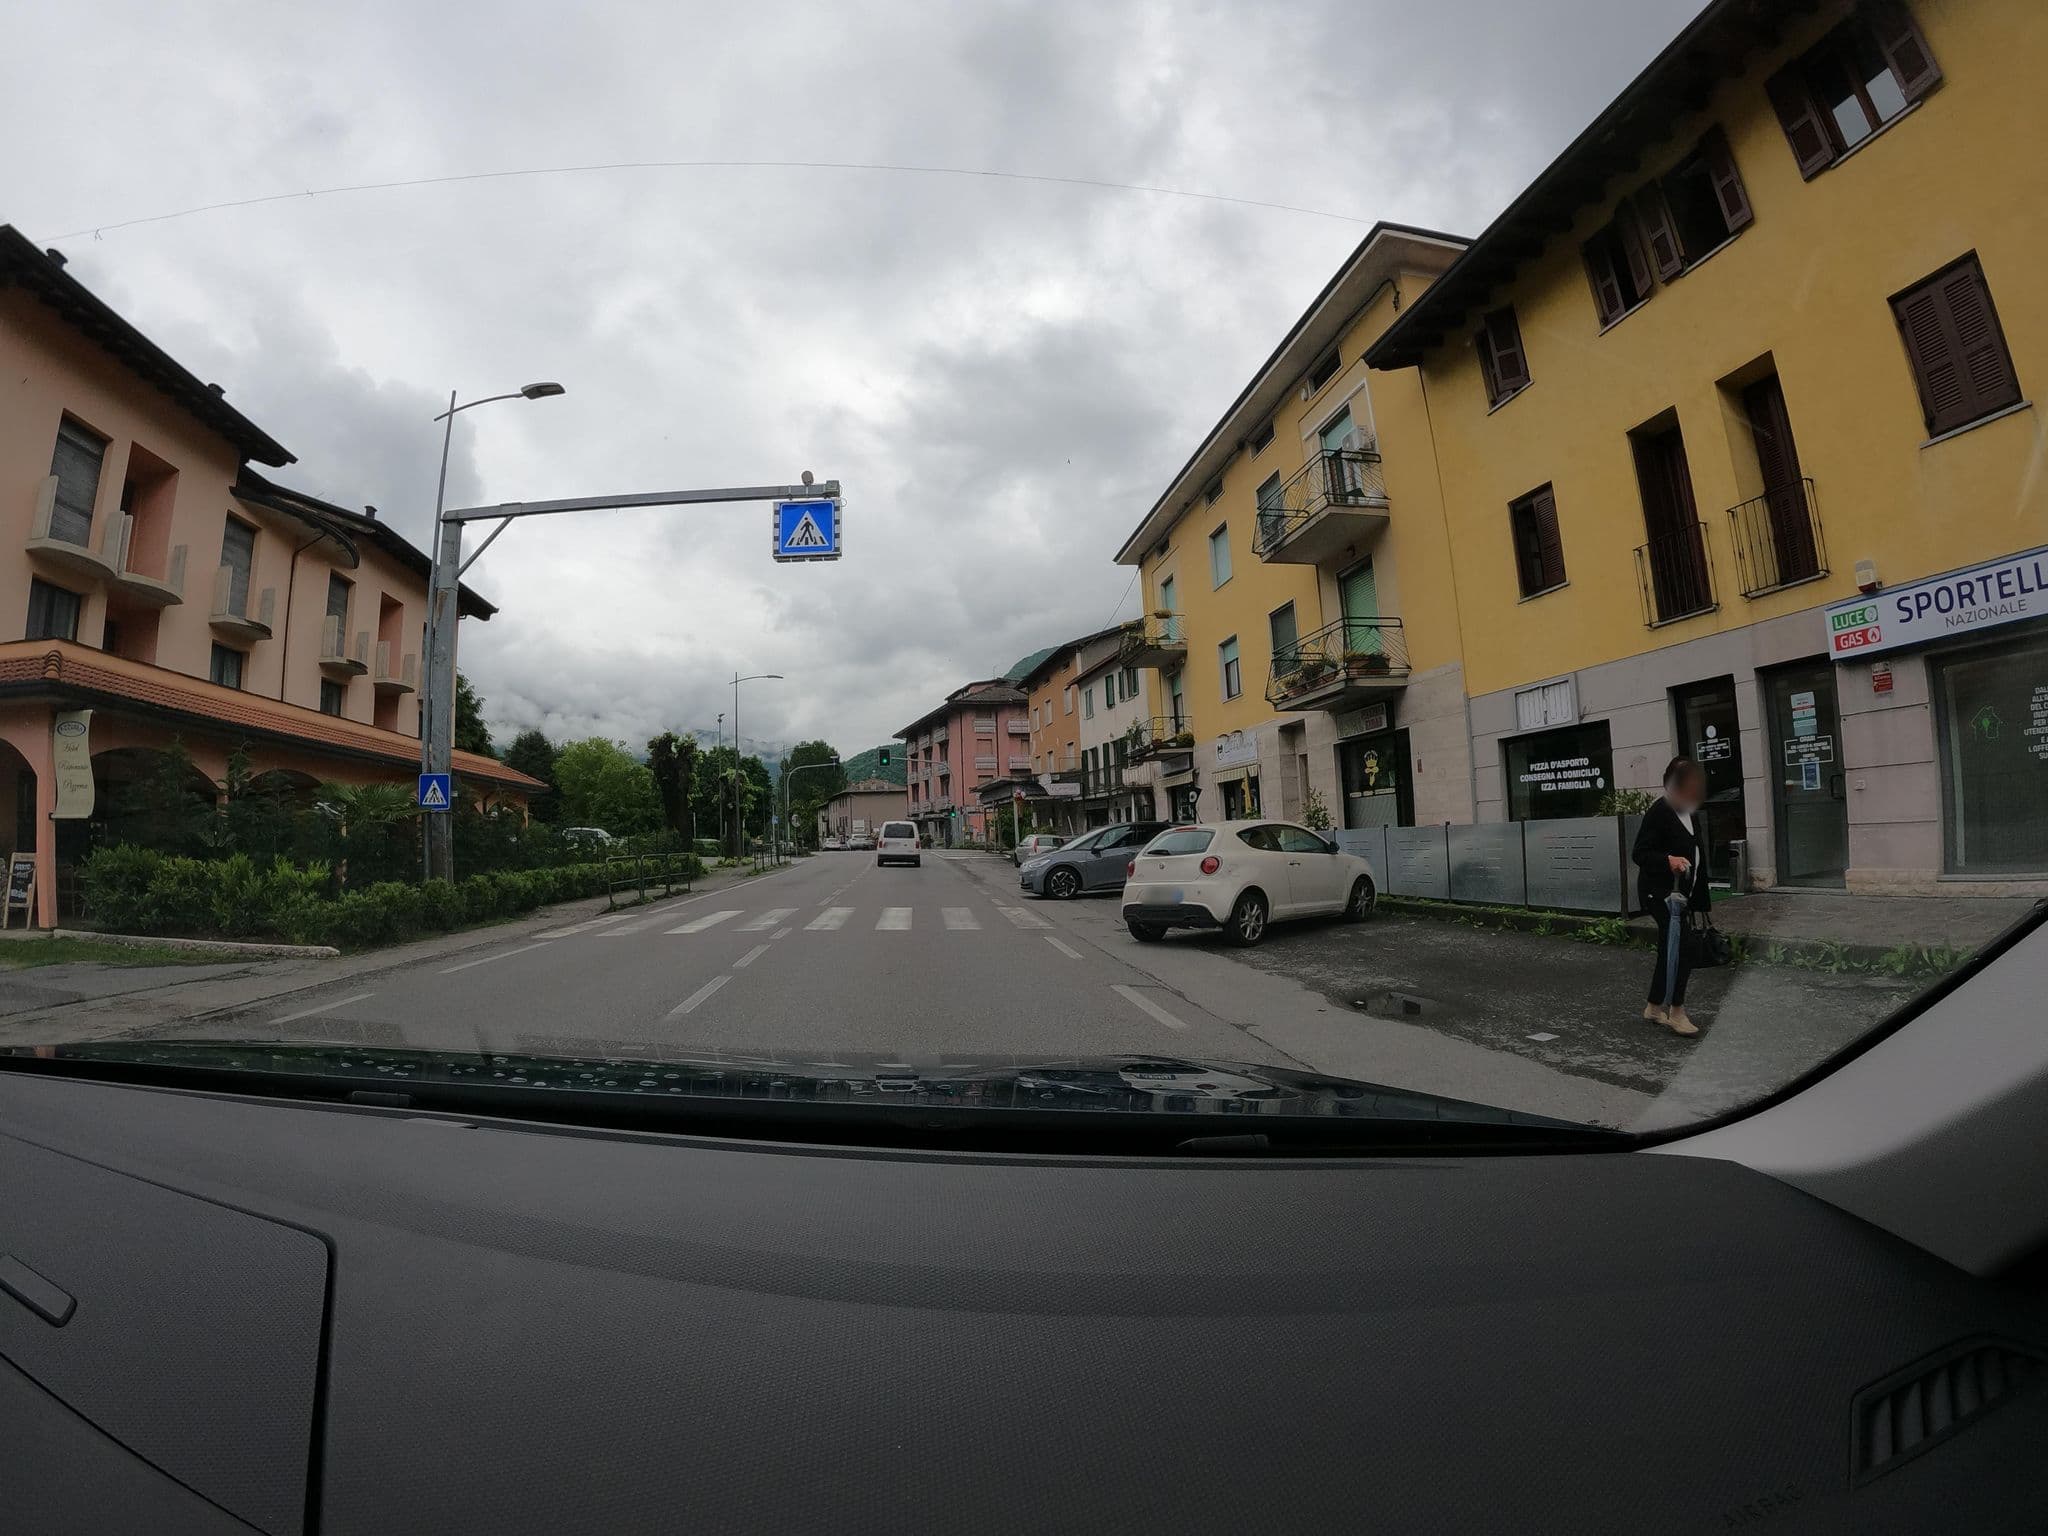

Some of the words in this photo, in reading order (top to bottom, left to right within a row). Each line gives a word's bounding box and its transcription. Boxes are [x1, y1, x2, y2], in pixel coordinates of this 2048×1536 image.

[1896, 562, 2048, 624] SPORTELL
[1833, 610, 1864, 629] LUCE
[1945, 599, 2028, 628] NAZIONALE
[1840, 631, 1864, 648] GAS
[1529, 761, 1550, 772] PIZZA
[1550, 757, 1589, 769] D'ASPORTO
[1519, 771, 1556, 783] CONSEGNA
[1556, 771, 1562, 779] A
[1562, 767, 1601, 779] DOMICILIO
[1557, 780, 1591, 790] FAMIGLIA
